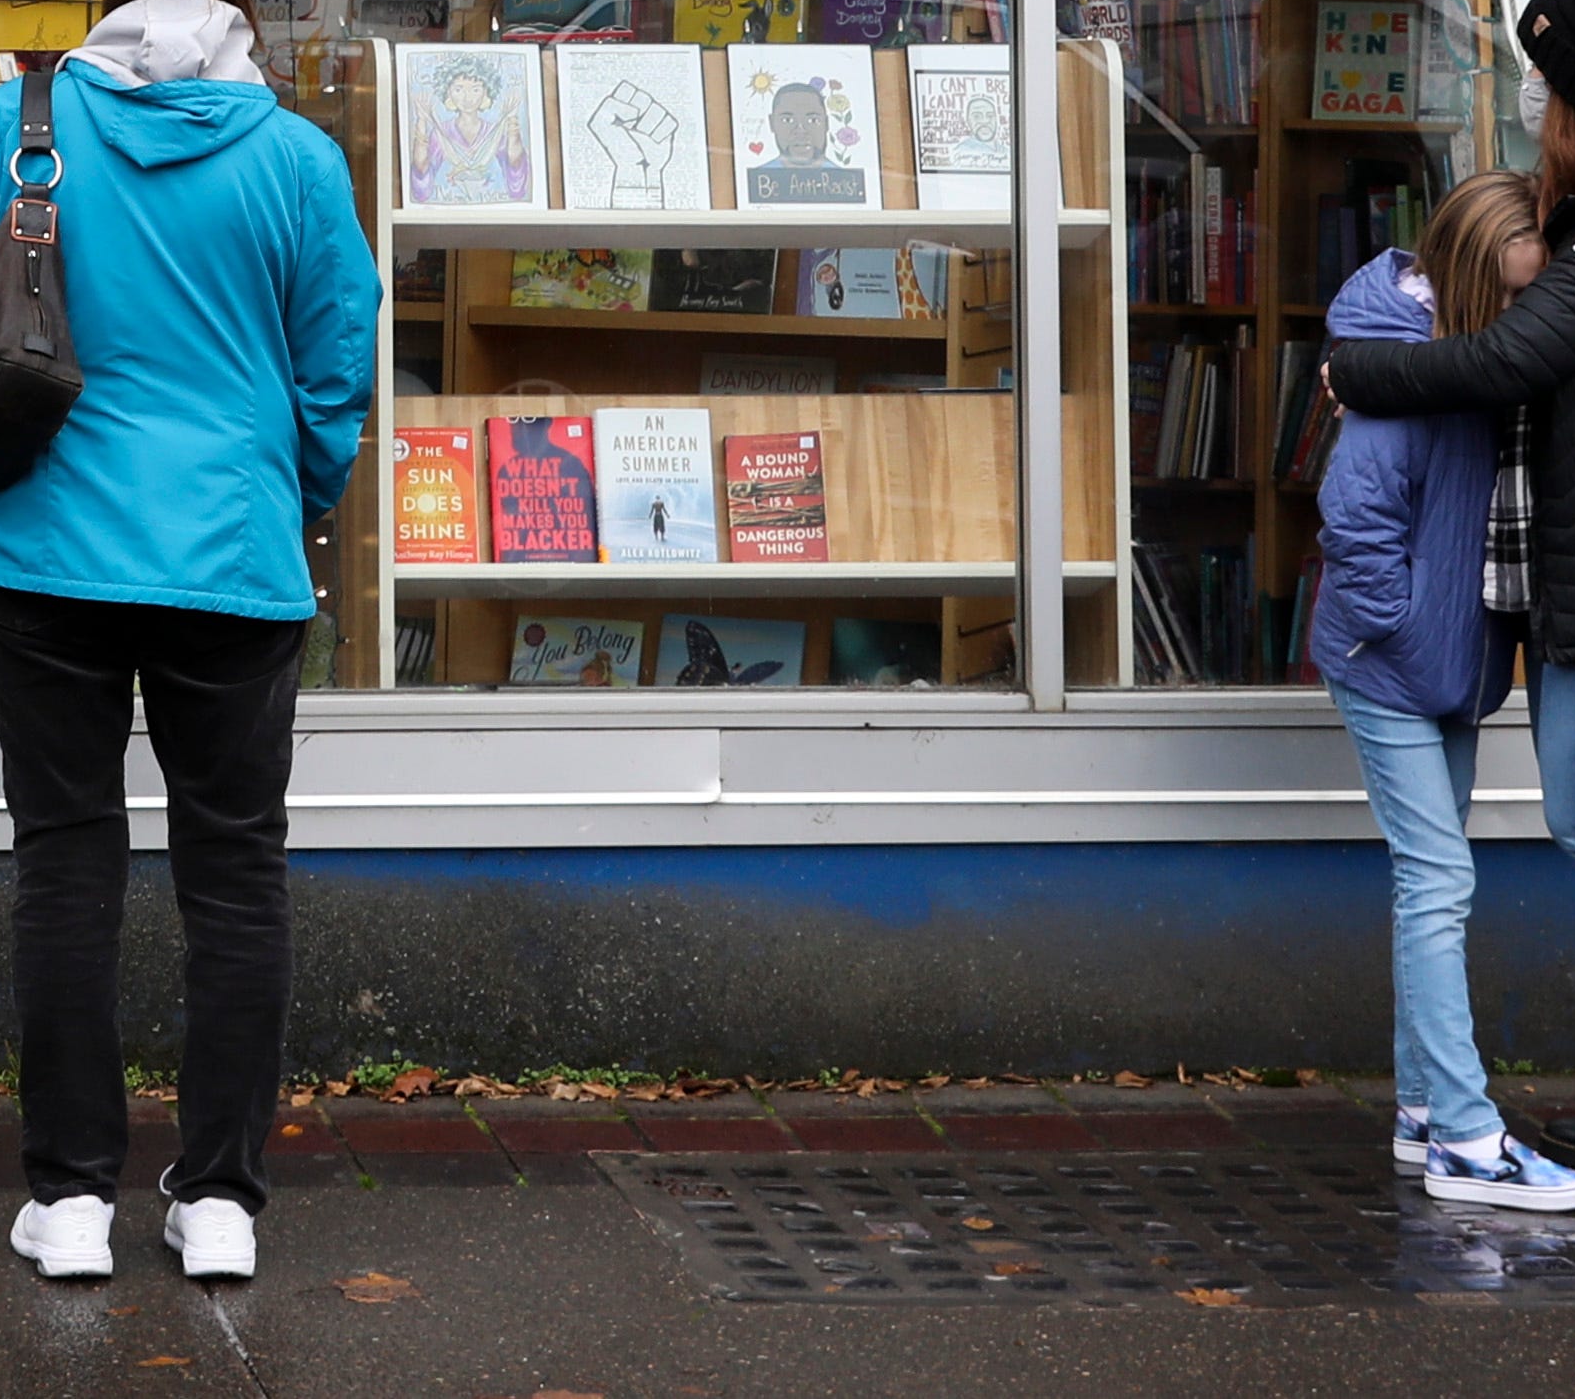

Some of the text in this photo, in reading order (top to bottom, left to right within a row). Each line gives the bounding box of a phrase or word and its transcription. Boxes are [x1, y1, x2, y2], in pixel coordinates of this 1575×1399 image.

[1321, 93, 1405, 114] GAGA
[758, 176, 780, 198] Be
[645, 416, 664, 431] AN
[415, 447, 443, 456] THE
[613, 437, 698, 451] AMERICAN
[622, 457, 691, 472] SUMMER
[741, 452, 809, 466] A BOUND
[505, 458, 562, 476] WHAT
[746, 466, 805, 480] WOMAN
[408, 469, 453, 484] SUN
[499, 478, 579, 497] DOESN'T
[519, 498, 584, 512] KILL YOU
[769, 497, 794, 507] IS A
[504, 514, 588, 528] MAKES YOU
[399, 524, 466, 540] SHINE
[737, 527, 824, 542] DANGEROUS
[502, 531, 593, 551] BLACKER
[757, 543, 804, 555] THING
